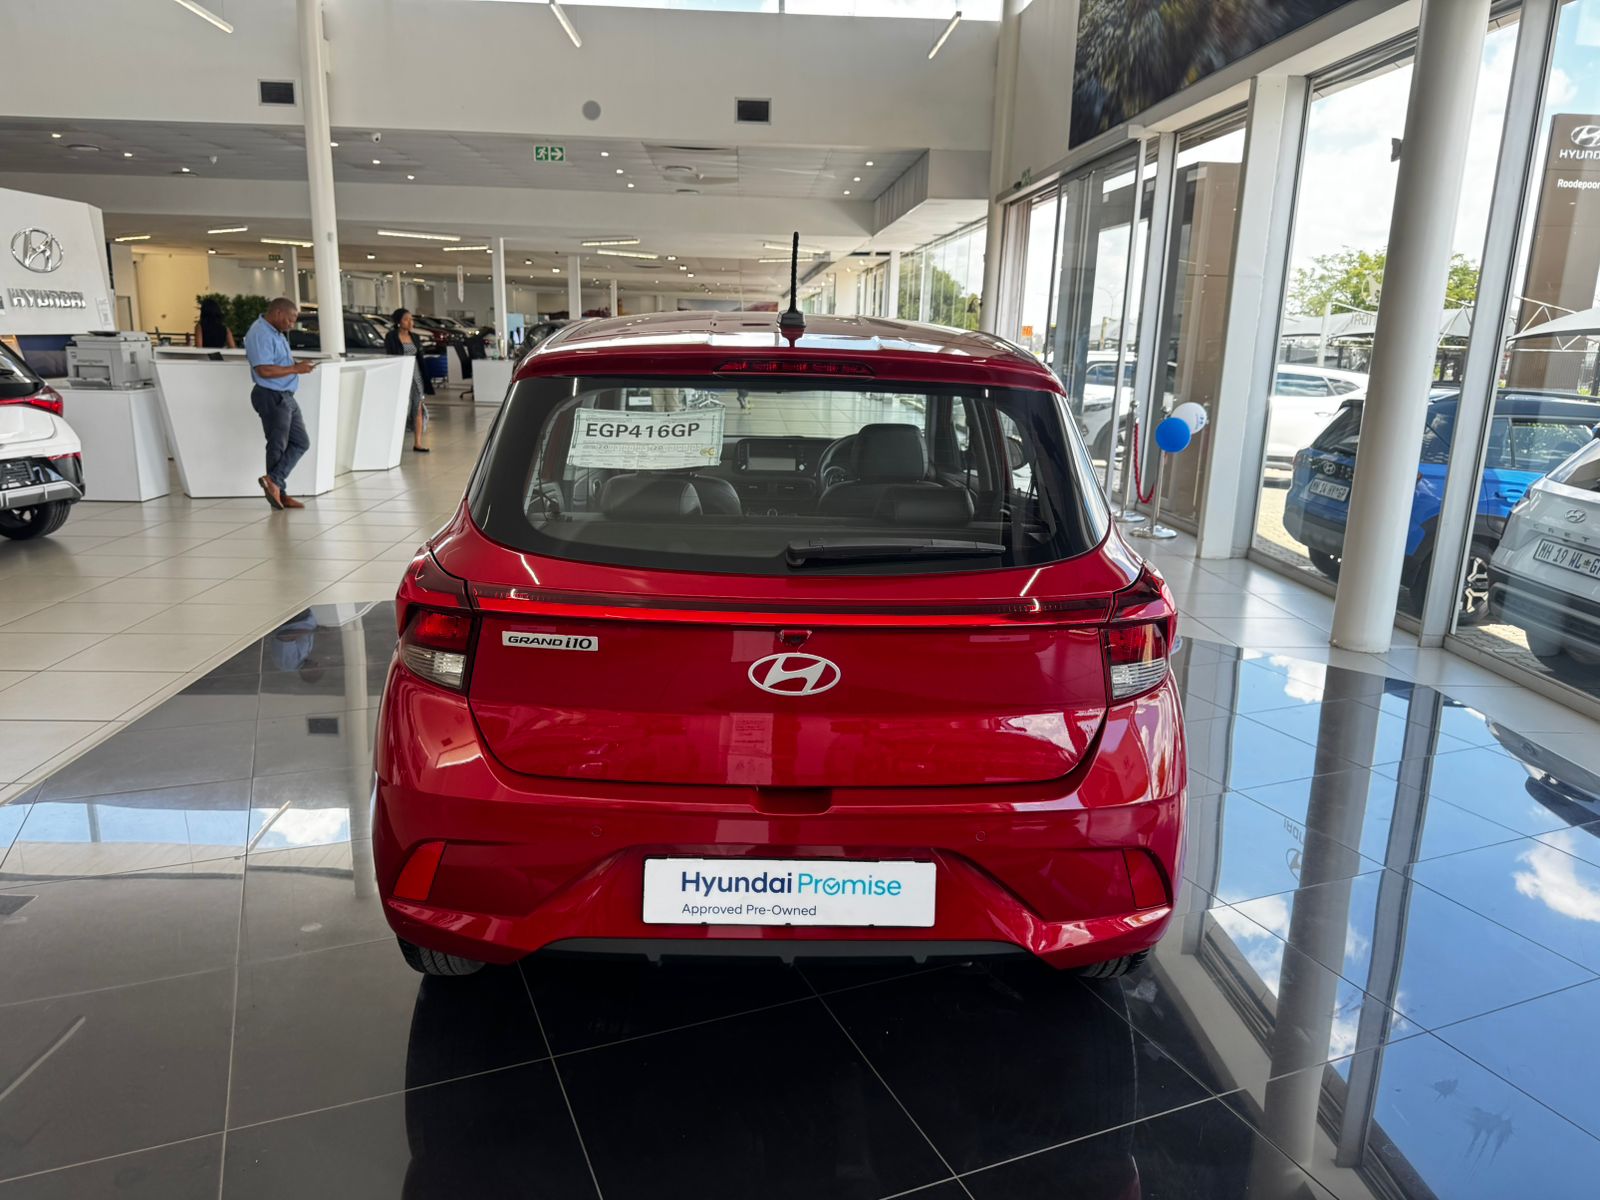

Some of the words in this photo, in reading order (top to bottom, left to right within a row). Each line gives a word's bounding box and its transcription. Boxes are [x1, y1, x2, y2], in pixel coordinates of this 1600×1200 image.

[585, 422, 700, 438] EGP416GP
[1538, 542, 1554, 560] MH
[1553, 548, 1568, 564] 19
[1568, 552, 1582, 569] WL
[508, 635, 563, 647] GRAND
[565, 637, 592, 649] i10
[681, 871, 792, 897] Hyundai
[798, 873, 901, 896] Promise
[681, 904, 743, 916] Approved
[746, 904, 817, 916] Pre-Owned
